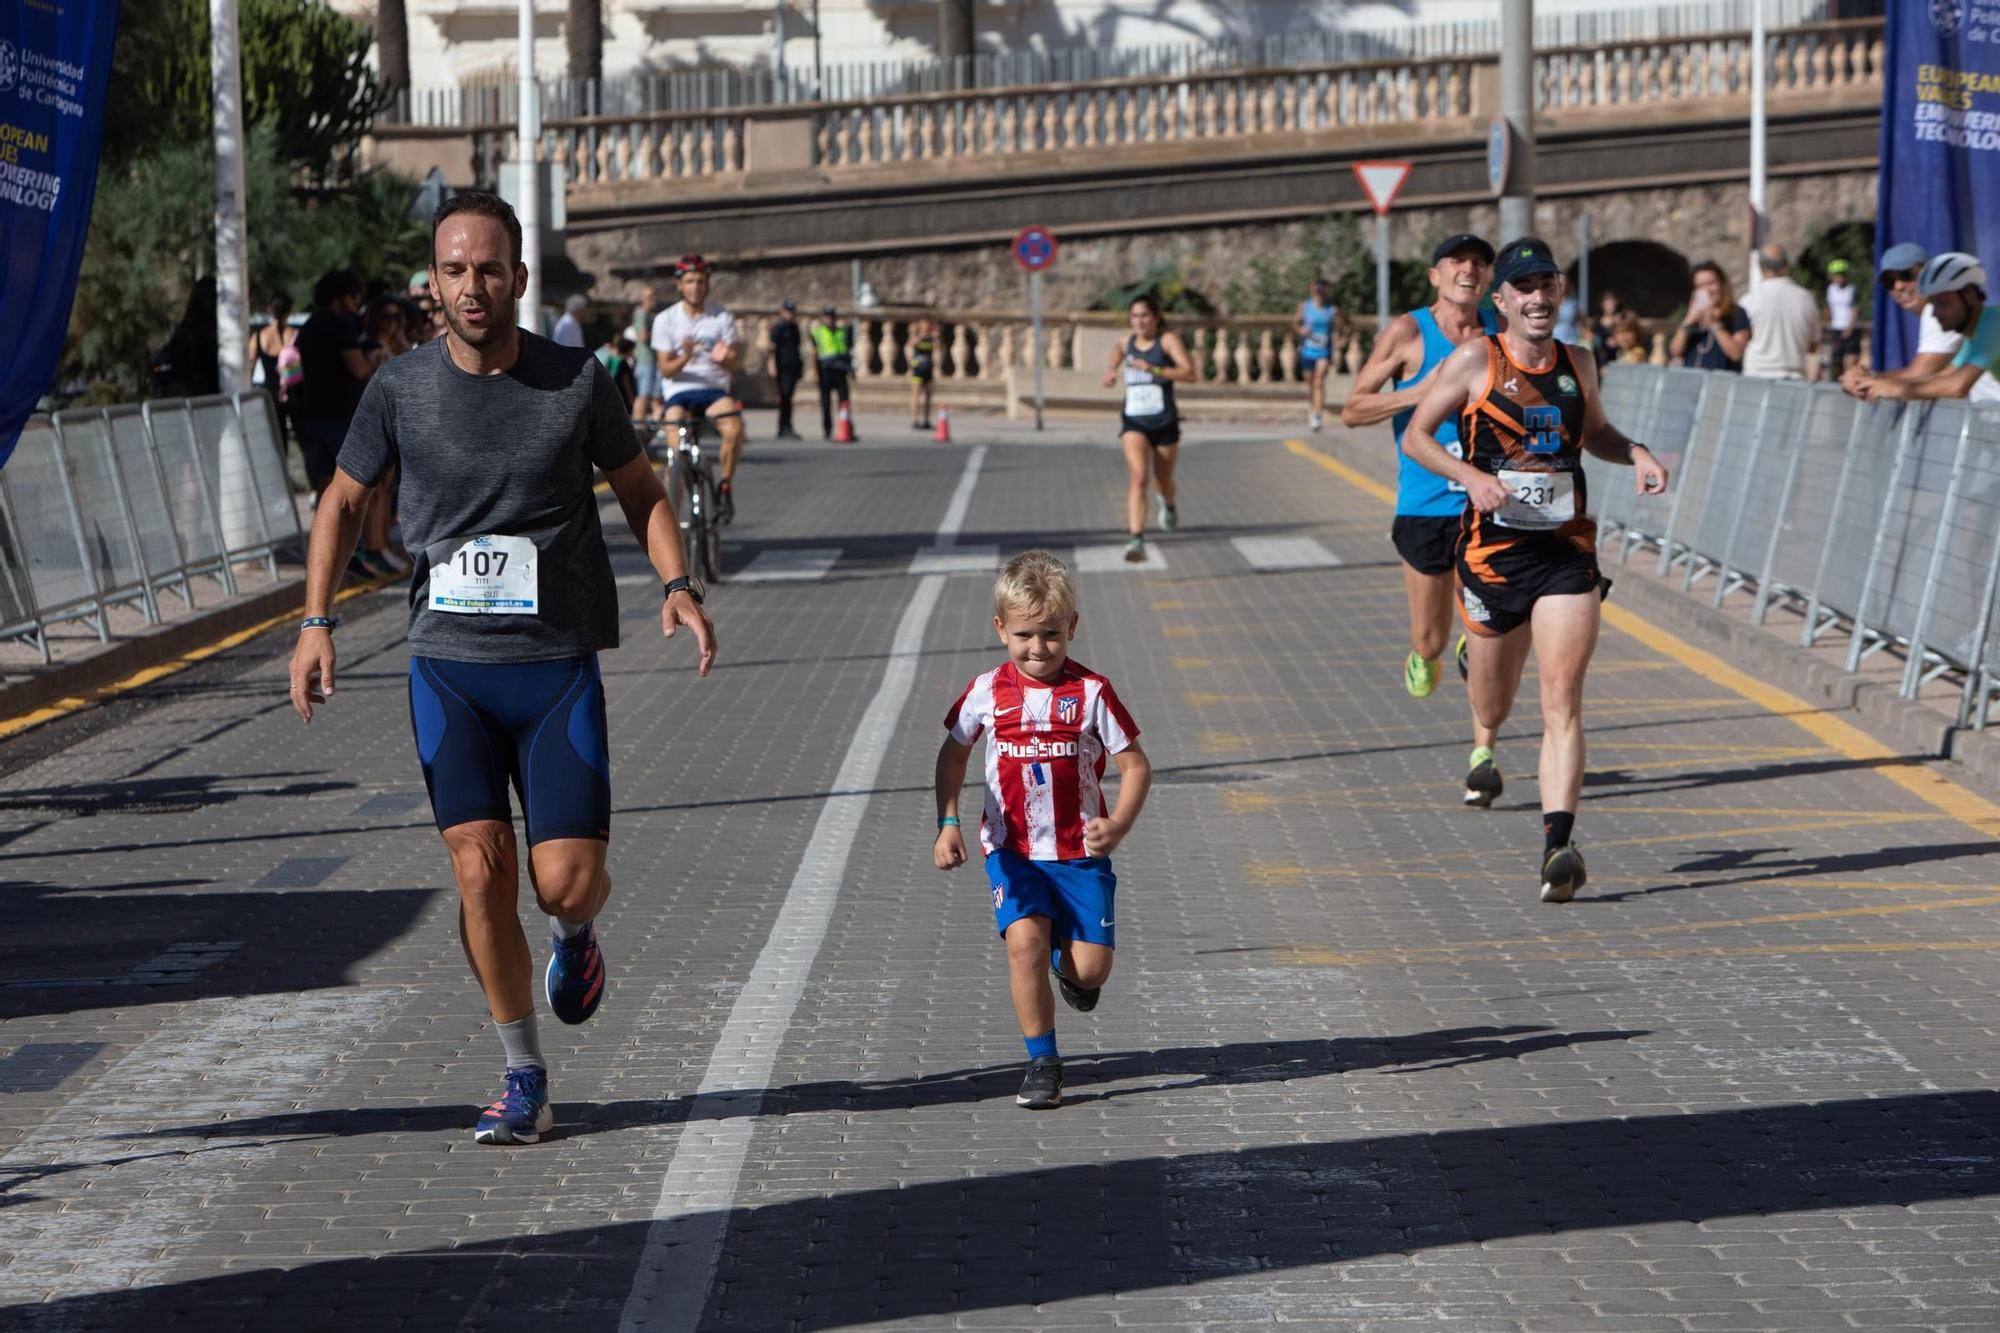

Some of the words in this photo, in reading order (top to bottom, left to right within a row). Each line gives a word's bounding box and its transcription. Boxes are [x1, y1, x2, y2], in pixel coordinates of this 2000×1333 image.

[19, 84, 33, 100] de
[1519, 486, 1556, 506] 231
[458, 550, 509, 576] 107
[475, 577, 489, 585] TITI
[996, 741, 1078, 758] Plus500
